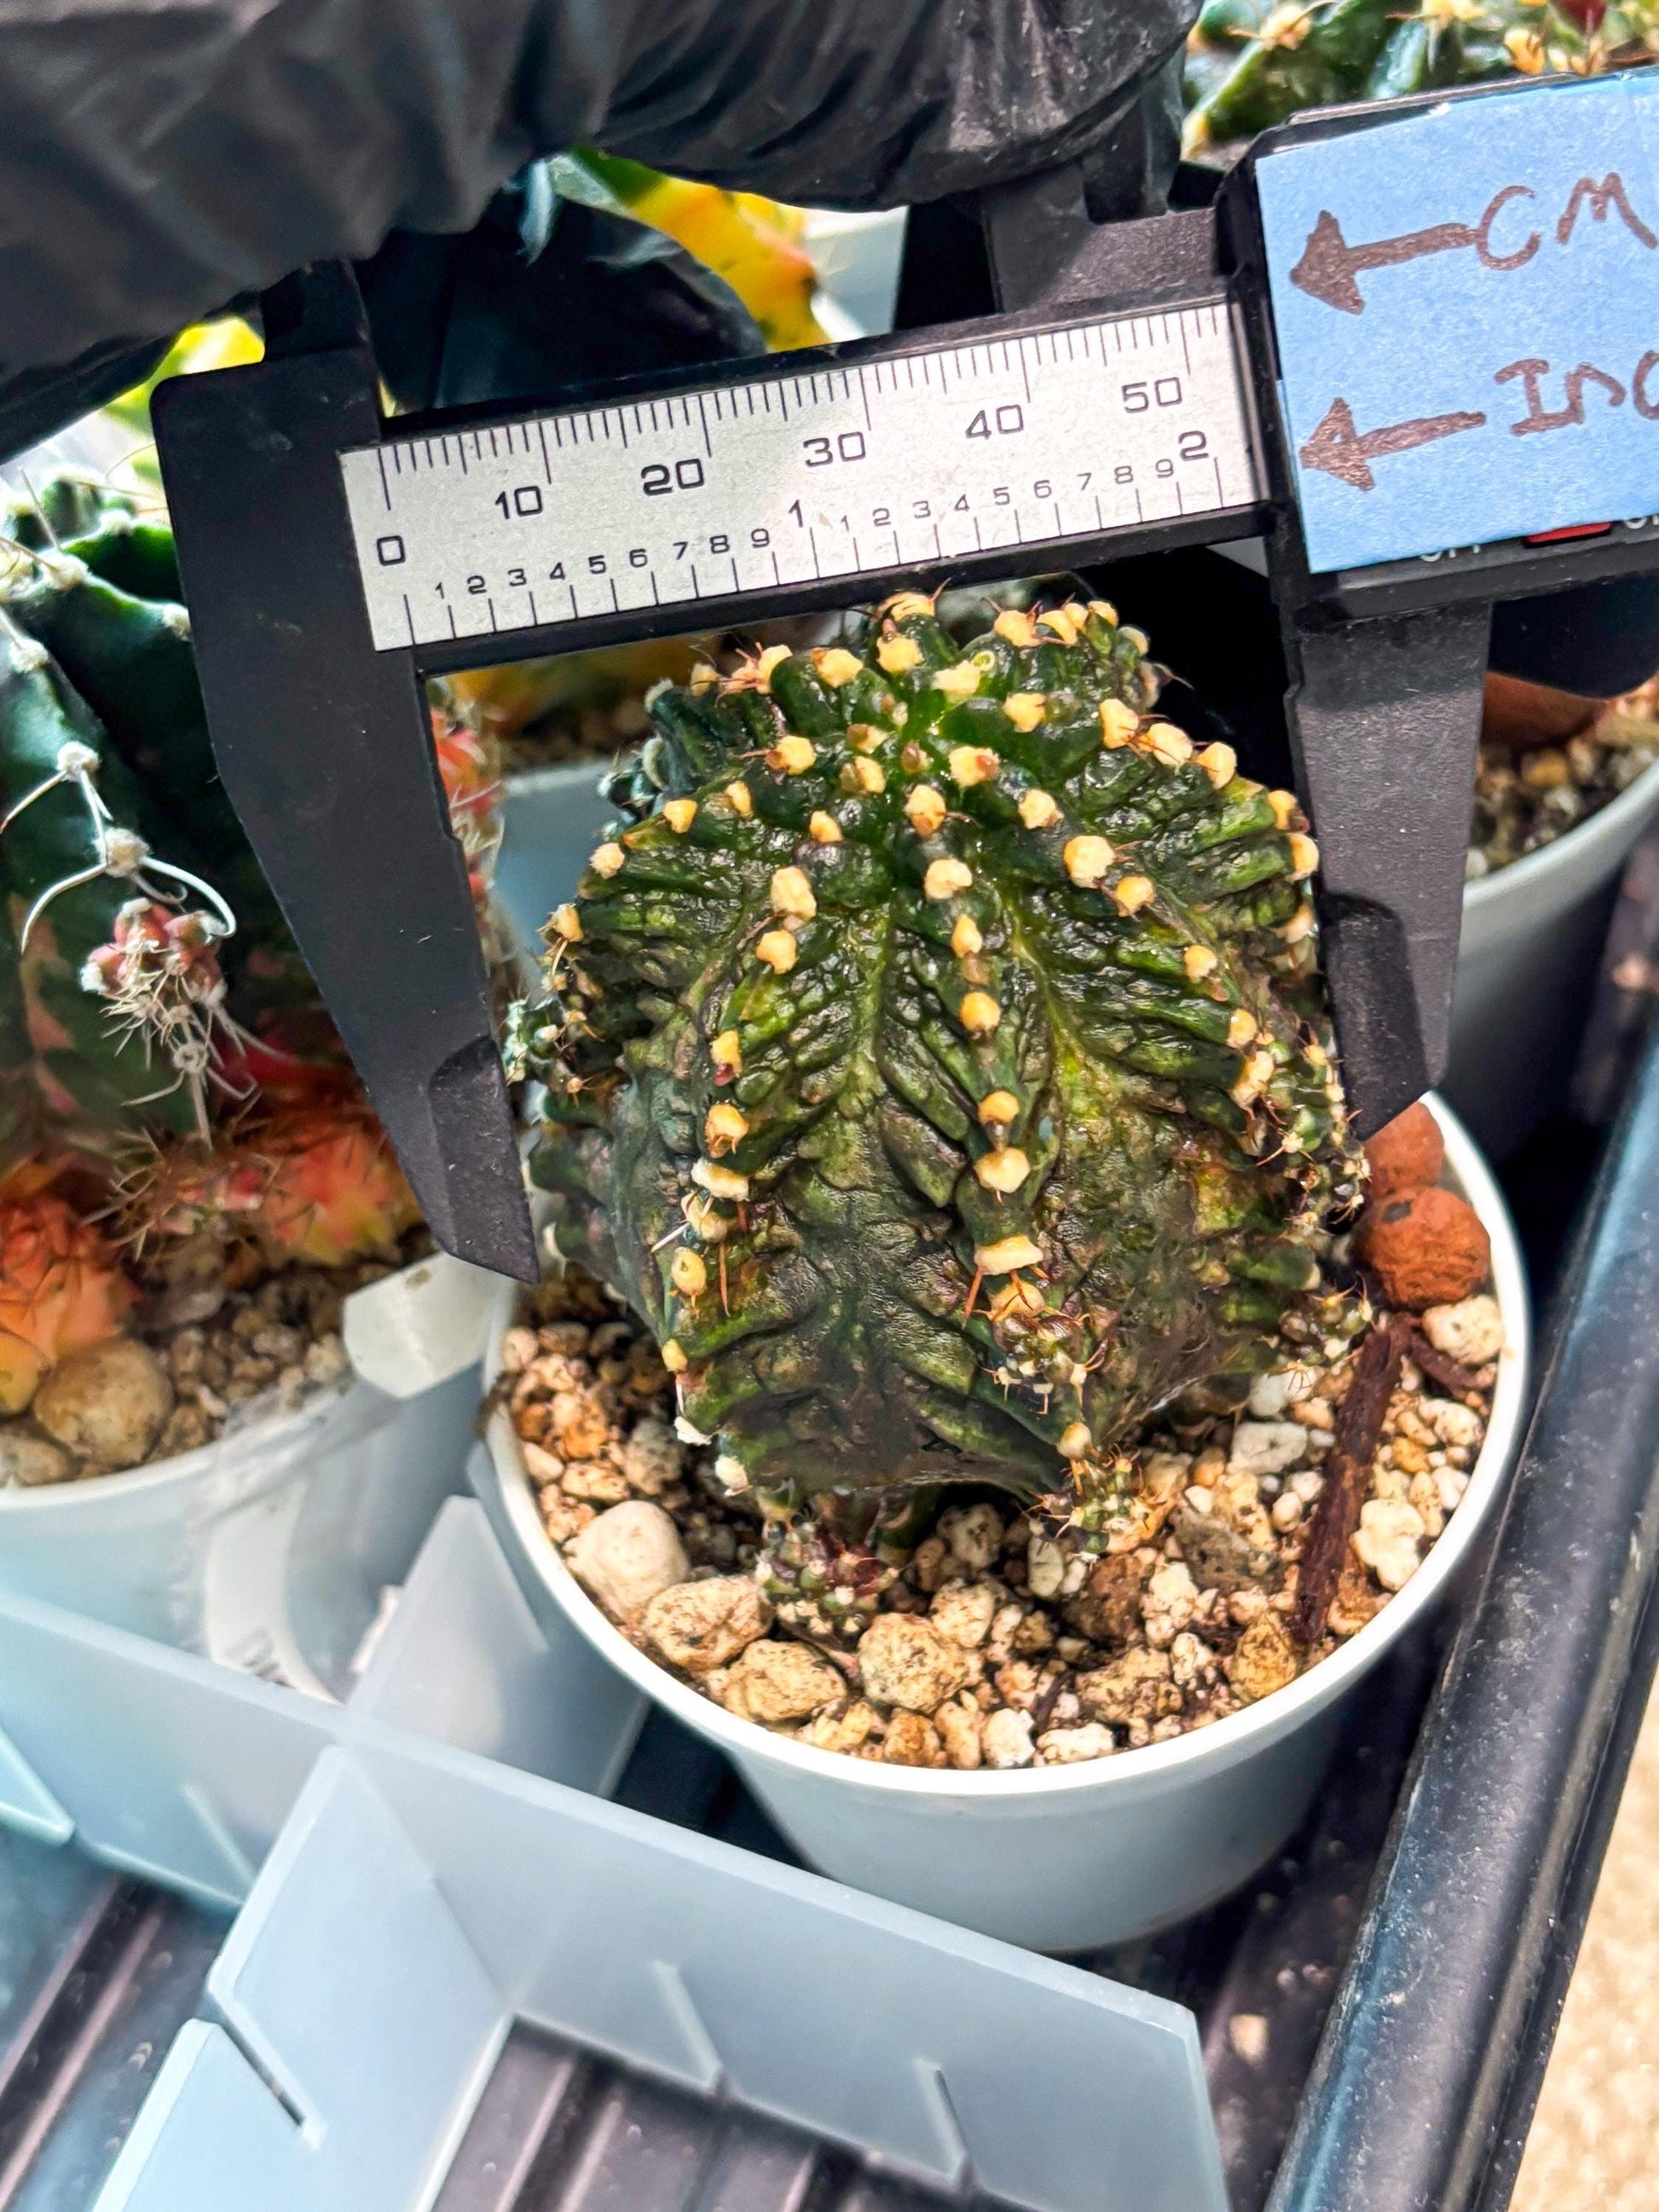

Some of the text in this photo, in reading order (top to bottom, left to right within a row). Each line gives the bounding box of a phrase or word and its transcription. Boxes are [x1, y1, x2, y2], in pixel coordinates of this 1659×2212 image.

[377, 377, 1182, 566] 0 10 20 30 40 50
[436, 430, 1209, 599] 1 2 3 4 5 6 7 8 9 1 1 2 3 4 5 6 7 8 9 2
